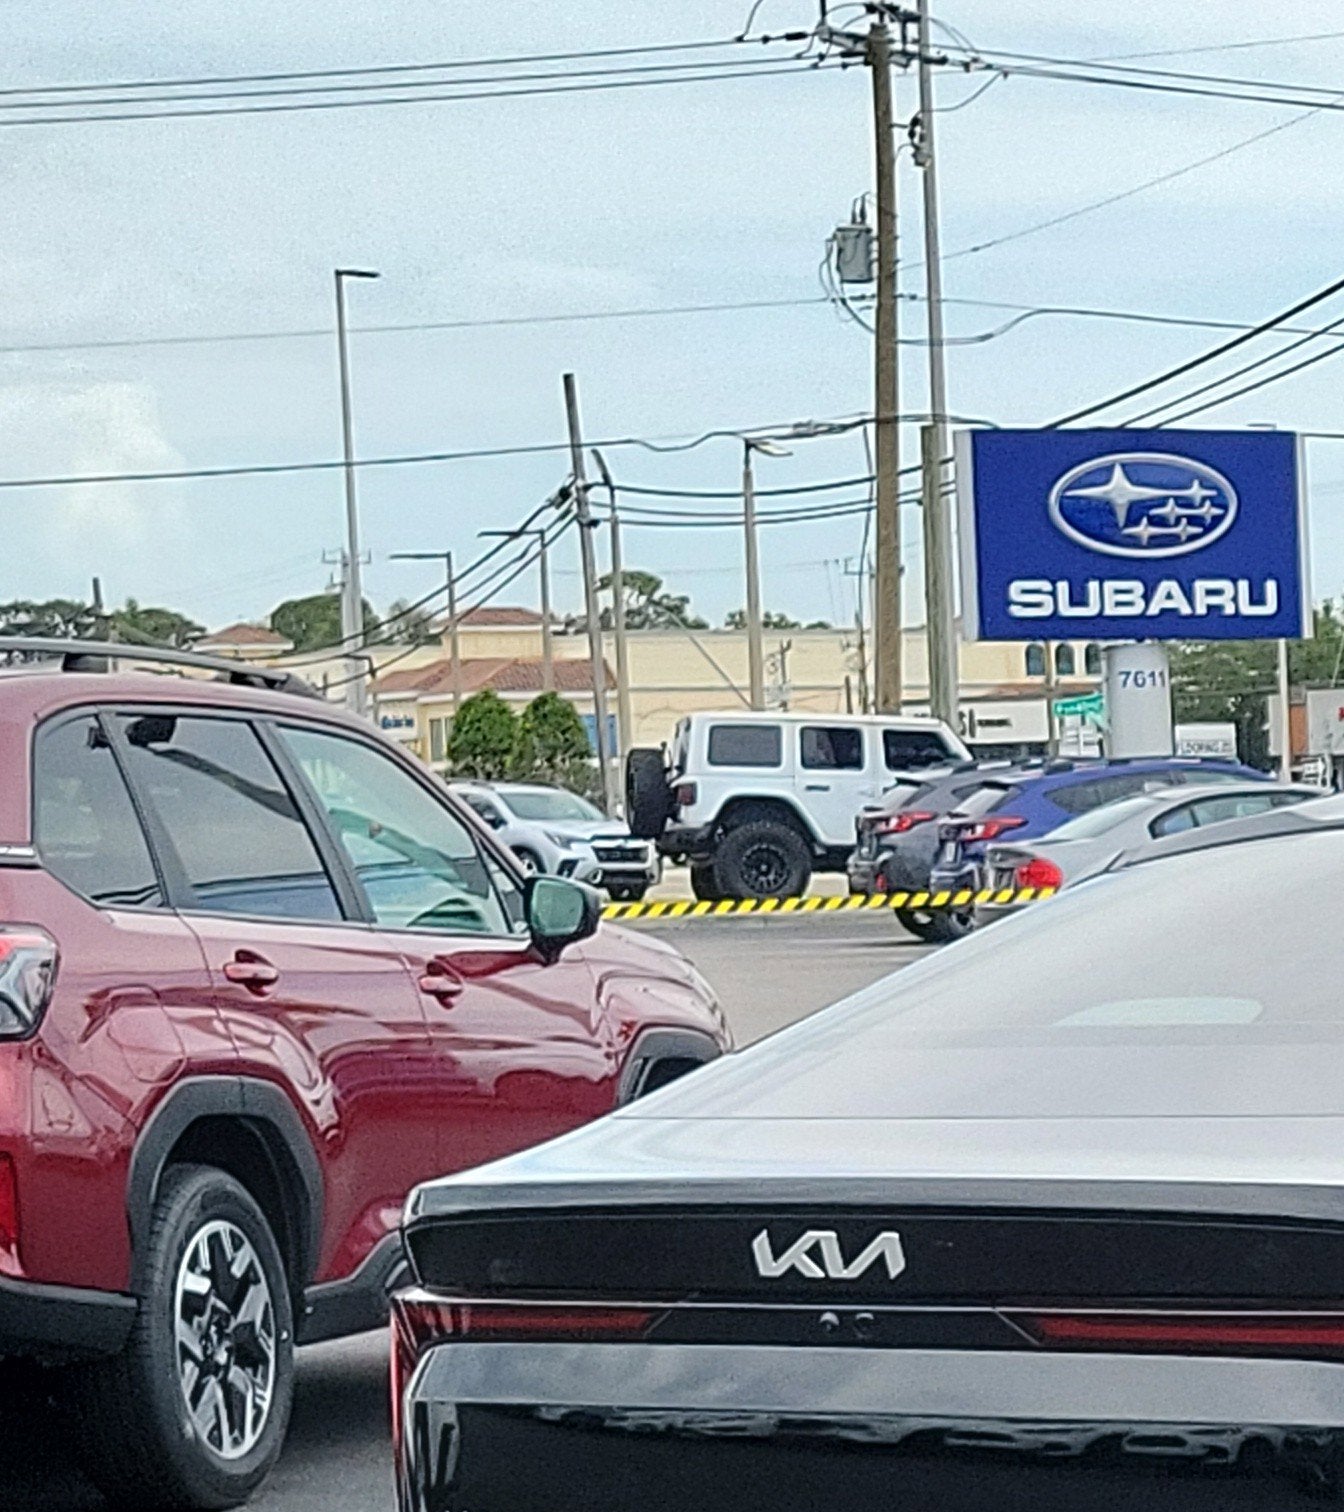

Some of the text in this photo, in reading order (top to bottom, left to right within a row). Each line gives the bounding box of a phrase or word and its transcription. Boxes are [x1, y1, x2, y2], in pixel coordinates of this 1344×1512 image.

[1008, 578, 1279, 618] SUBARU
[1118, 670, 1166, 688] 7611
[751, 1228, 906, 1280] KIA
